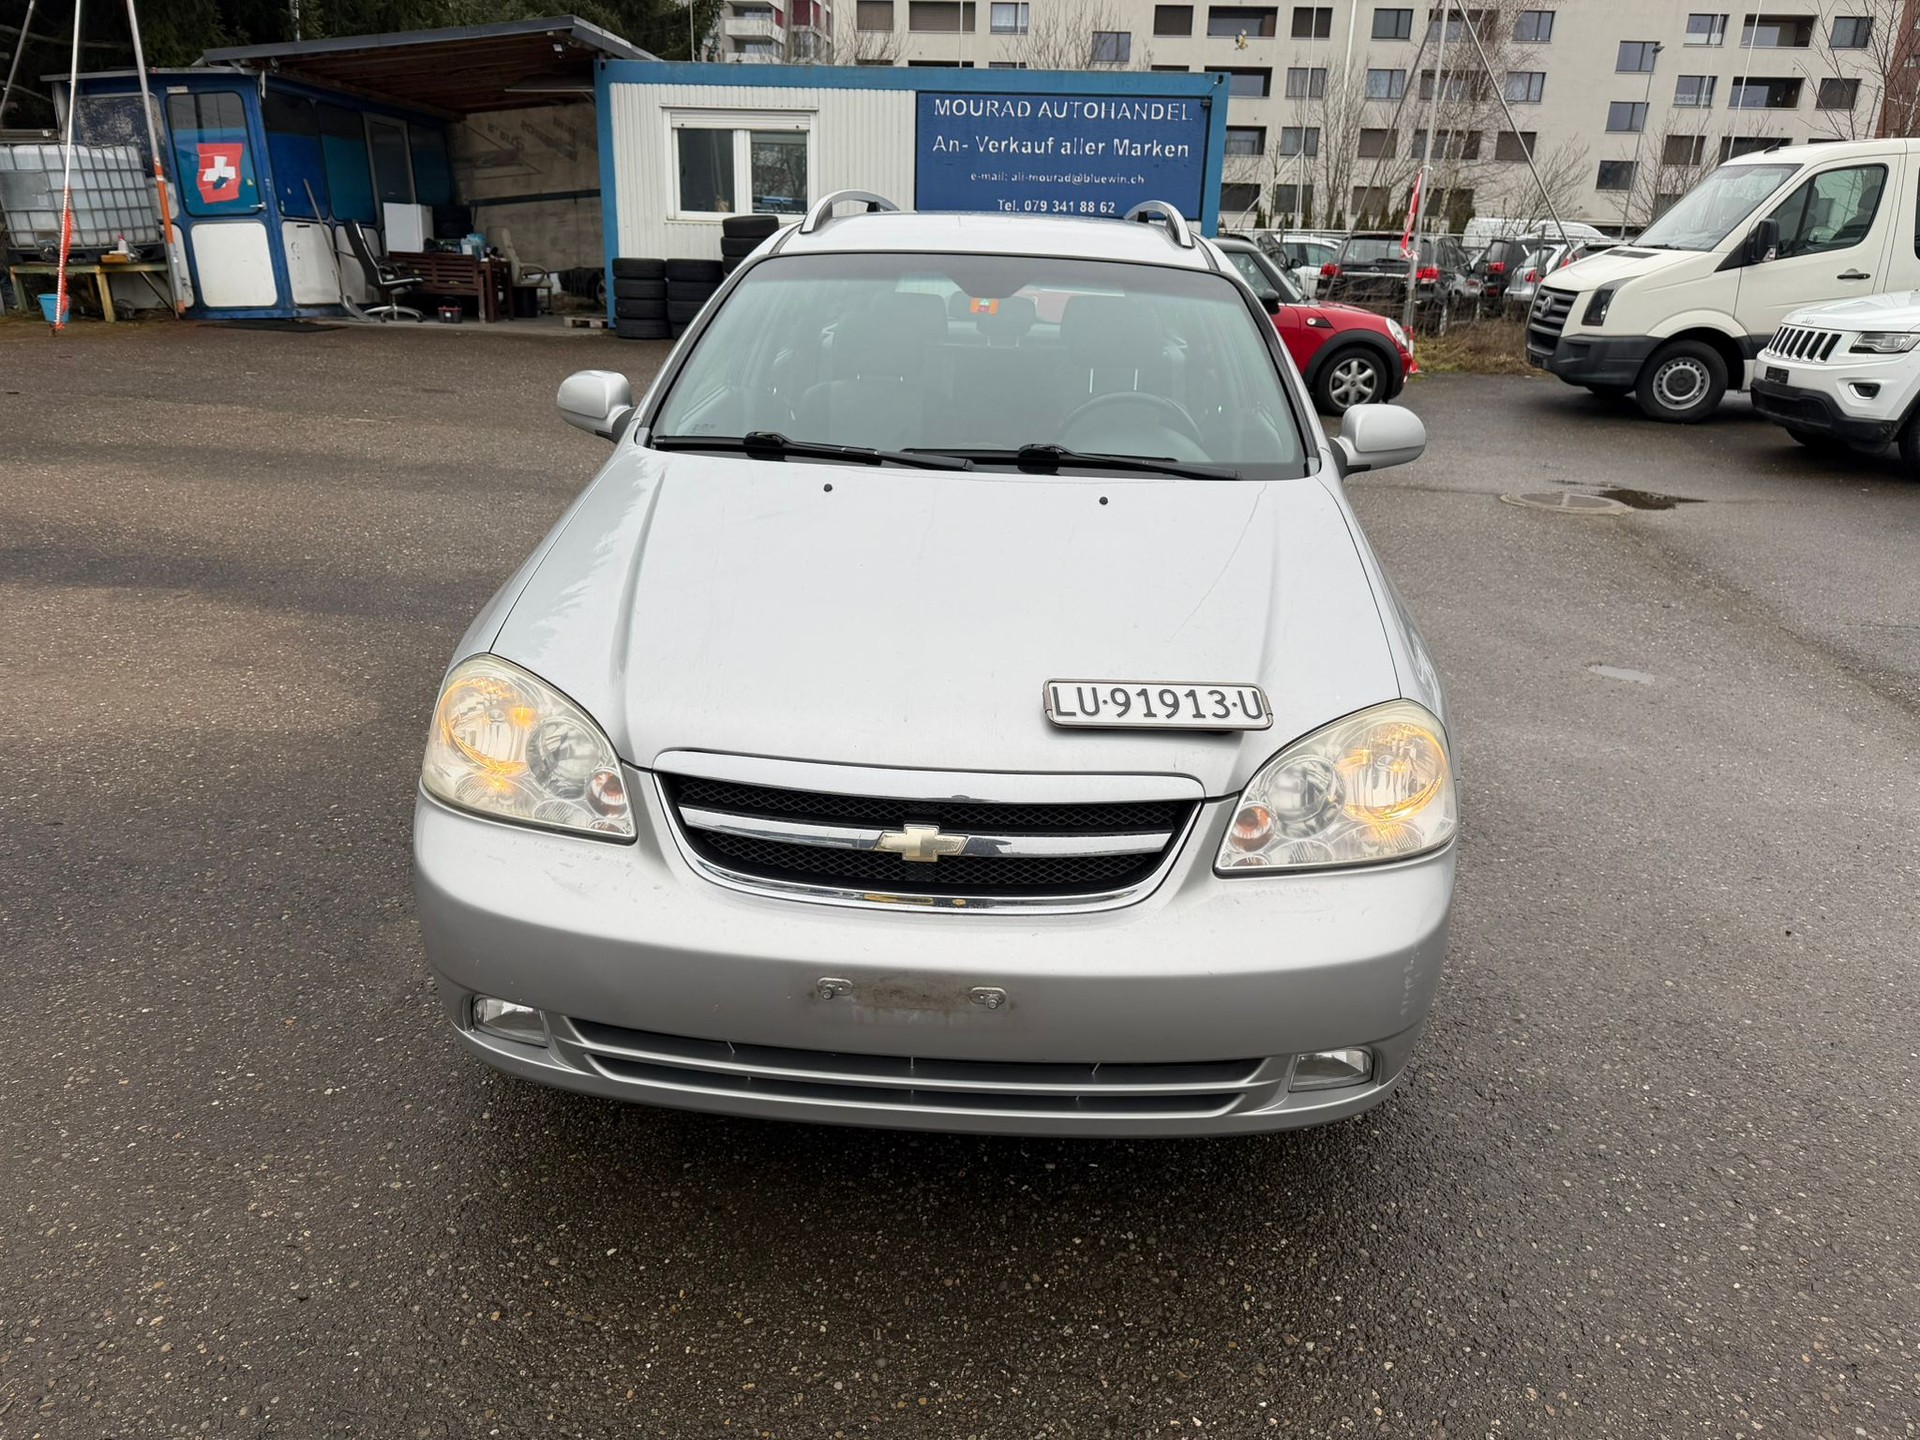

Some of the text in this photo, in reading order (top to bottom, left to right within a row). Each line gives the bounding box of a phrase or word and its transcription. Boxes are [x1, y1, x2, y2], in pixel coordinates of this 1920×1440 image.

[934, 99, 1193, 121] MOURAD AUTOHANDEL
[933, 136, 1189, 157] An- Verkauf aller Marken
[970, 171, 1144, 185] e-mail: ali-mourad@bluewin.ch
[998, 199, 1115, 214] Tel. 079 341 88 62
